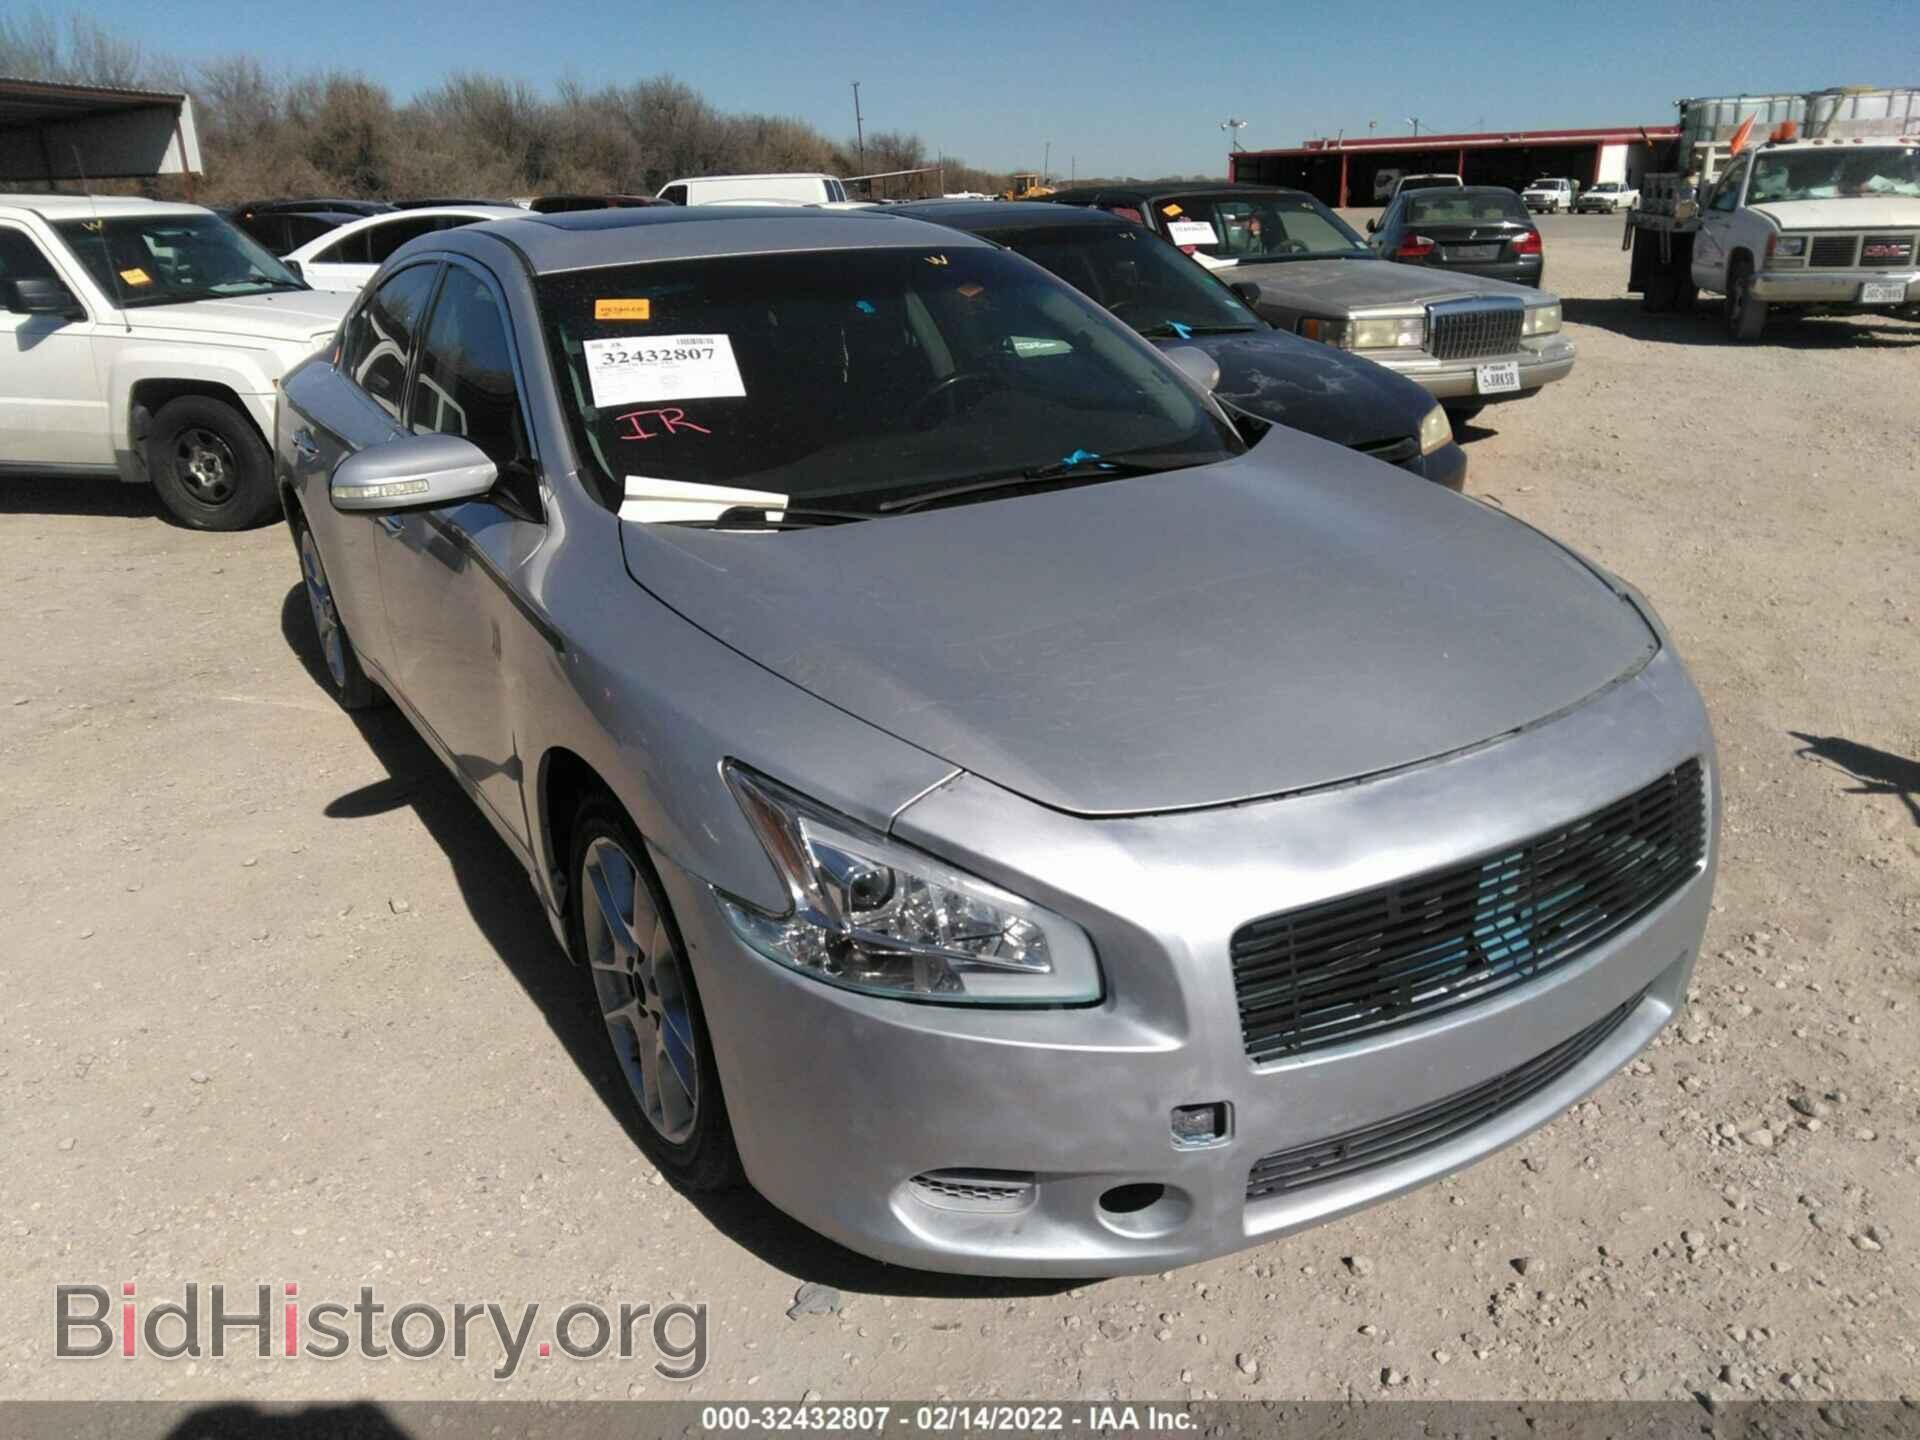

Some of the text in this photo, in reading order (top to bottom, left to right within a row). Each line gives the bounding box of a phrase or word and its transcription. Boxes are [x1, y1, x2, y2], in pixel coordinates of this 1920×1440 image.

[1864, 244, 1911, 257] GMC
[602, 348, 714, 365] 32432807
[615, 407, 712, 439] IR
